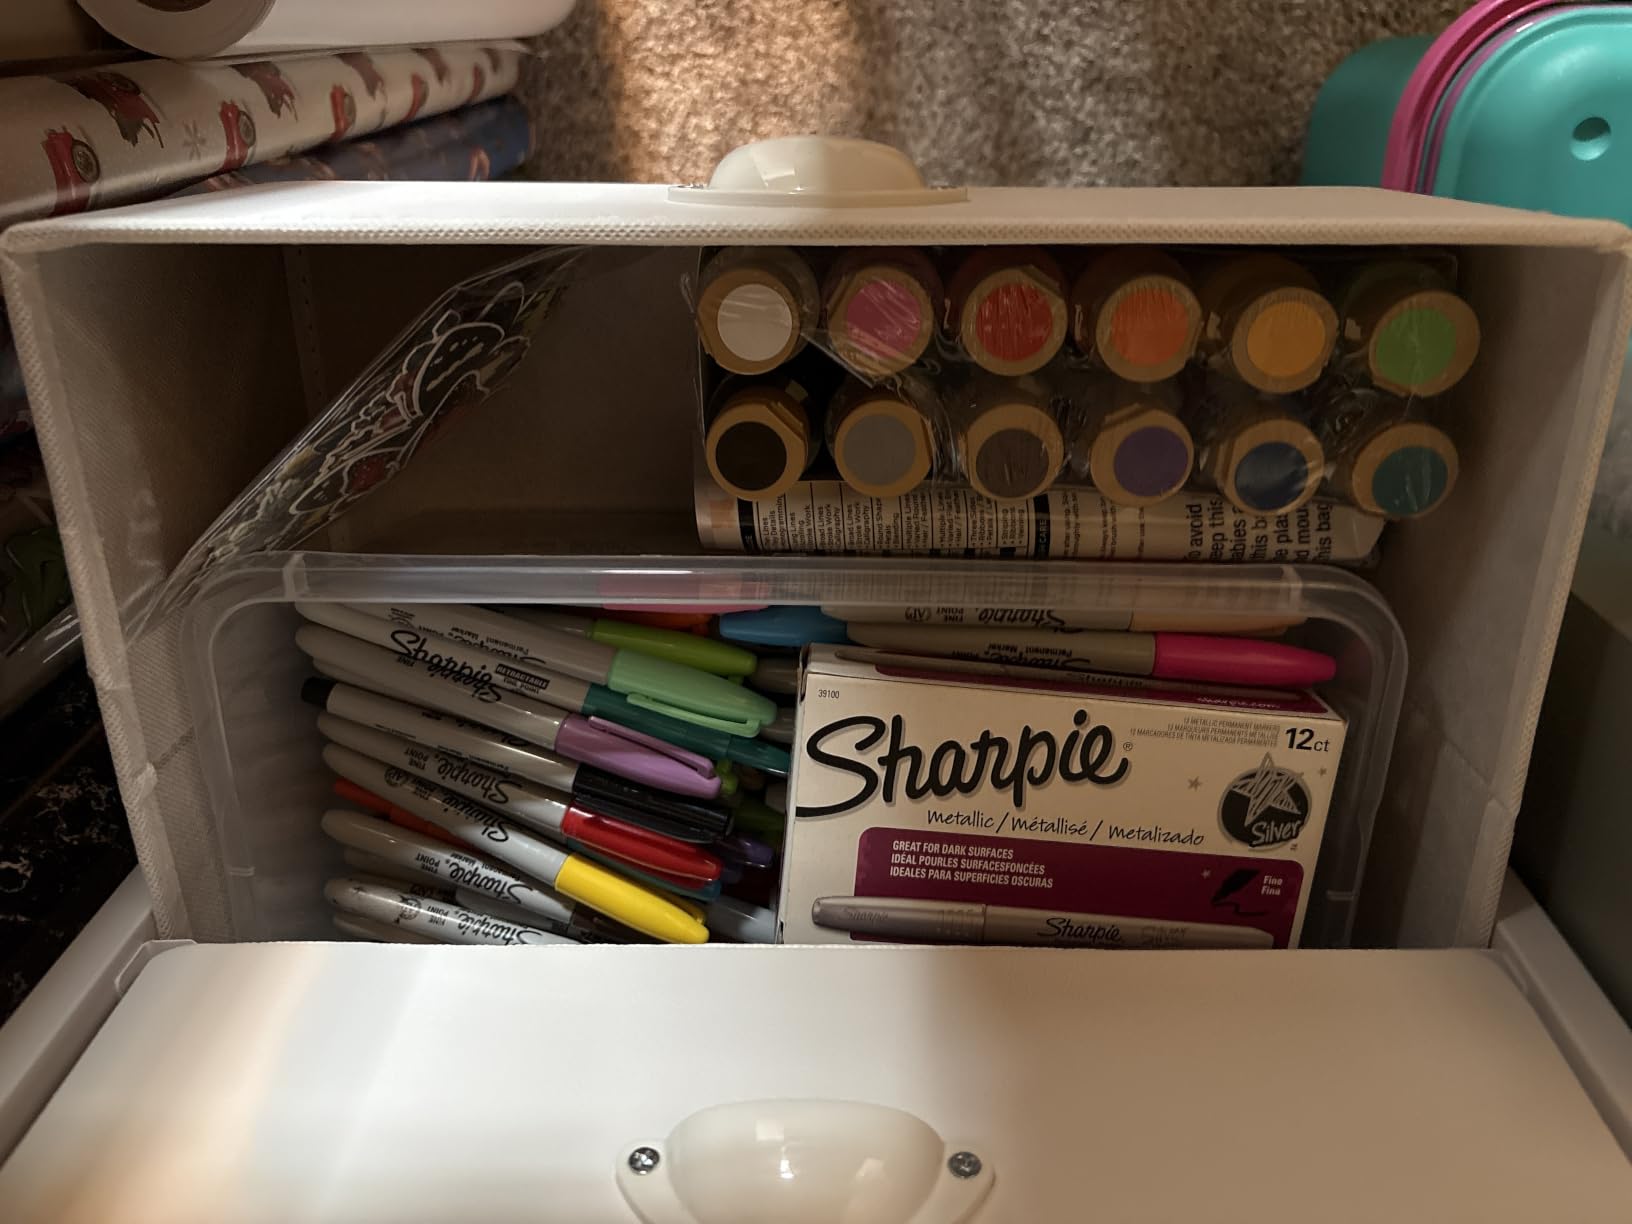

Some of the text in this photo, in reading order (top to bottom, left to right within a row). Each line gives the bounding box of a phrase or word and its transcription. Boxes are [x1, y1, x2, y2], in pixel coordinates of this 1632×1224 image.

[863, 505, 871, 545] Calligraphy
[1039, 519, 1048, 544] CARE
[1185, 503, 1203, 547] avoid
[1207, 497, 1228, 561] eep this
[1250, 535, 1268, 561] this
[935, 607, 965, 616] POINT
[943, 615, 964, 624] FINE
[450, 626, 530, 657] Permanent Marker
[988, 643, 1073, 658] Permanent Marker
[496, 665, 549, 689] RETRACTABLE
[818, 689, 841, 699] 39100
[1137, 728, 1176, 740] MARCADORES
[1176, 732, 1184, 740] DE
[1185, 733, 1201, 743] TINTA
[1219, 720, 1252, 730] PERMANENT
[403, 746, 430, 763] POINT
[408, 758, 427, 771] FINE
[795, 709, 1129, 817] Sharpie
[438, 750, 523, 805] Sharpie
[442, 793, 510, 842] Sharpie
[1249, 819, 1304, 847] Silver
[416, 851, 441, 869] POINT
[450, 851, 477, 868] Marker
[892, 840, 1014, 860] GREAT FOR DARK SURFACES
[420, 863, 439, 875] FINE
[891, 852, 1046, 876] IDÉAL POURLES SURFACESFONCÉES
[449, 860, 536, 904] Sharpie
[889, 867, 1054, 890] IDEALES PARA SUPERFICIES OSCURAS
[1262, 875, 1284, 887] Fine
[1261, 885, 1281, 897] Fina
[426, 905, 450, 918] POINT
[457, 911, 543, 945] Sharpie
[1036, 917, 1122, 943] Sharpie
